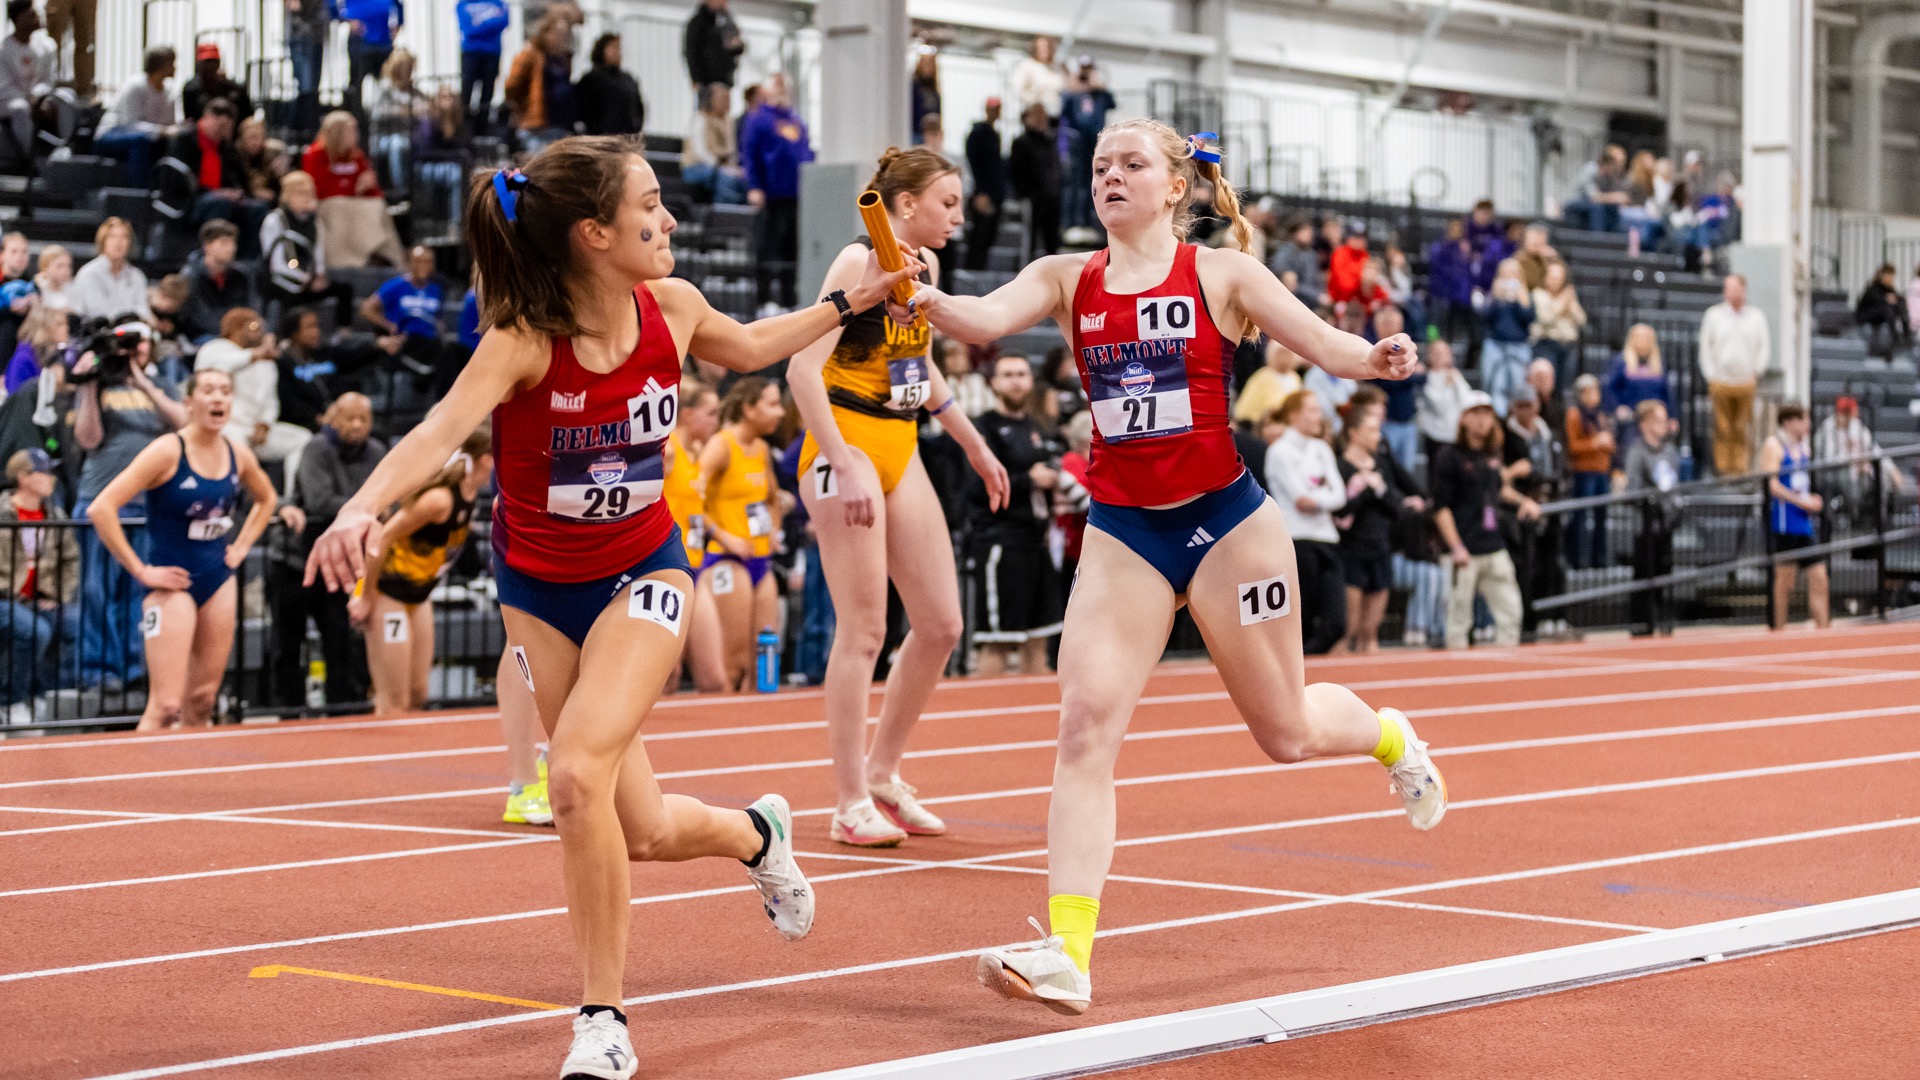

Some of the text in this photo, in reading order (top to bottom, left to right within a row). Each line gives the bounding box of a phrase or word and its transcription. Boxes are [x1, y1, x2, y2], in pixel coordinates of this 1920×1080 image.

[1081, 311, 1107, 331] VALLEY
[1141, 301, 1190, 330] 10
[1082, 338, 1187, 366] BELMONT
[551, 390, 586, 410] VALLEY
[634, 394, 674, 433] 10
[1123, 396, 1156, 432] 27
[549, 419, 631, 451] BELMO
[816, 464, 832, 494] 7
[582, 486, 630, 517] 29
[634, 584, 679, 622] 10
[1242, 581, 1286, 615] 10
[388, 619, 401, 637] 7
[516, 651, 529, 682] 0
